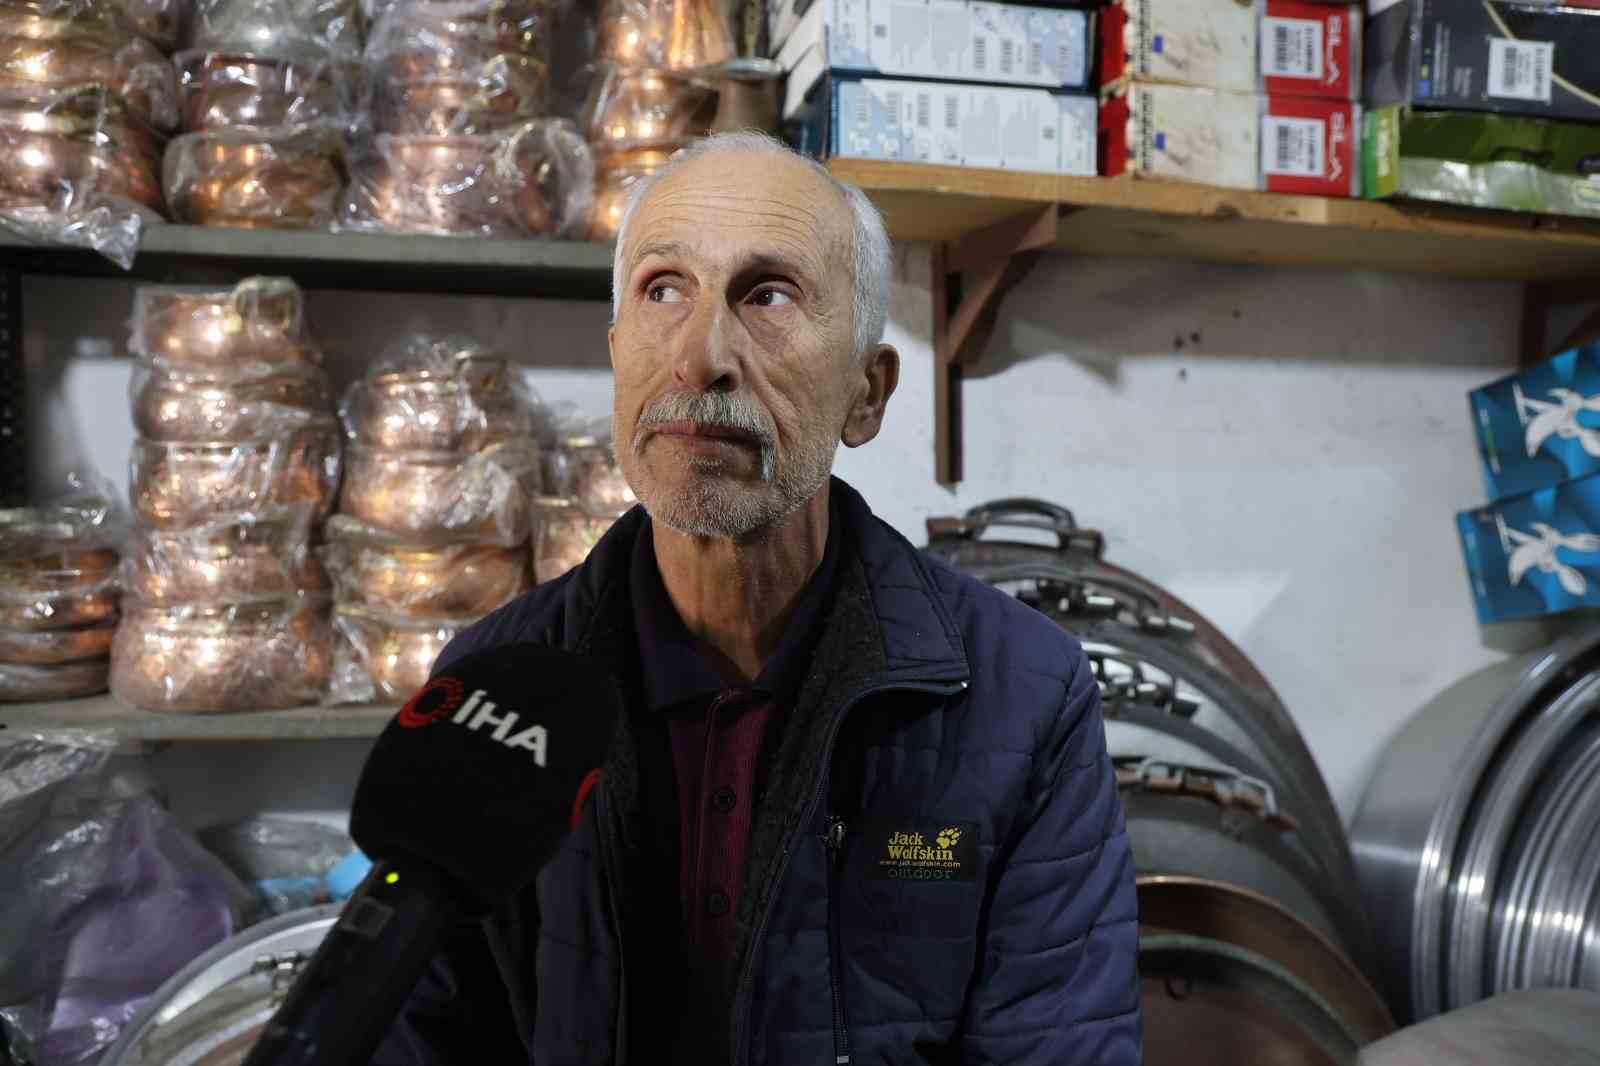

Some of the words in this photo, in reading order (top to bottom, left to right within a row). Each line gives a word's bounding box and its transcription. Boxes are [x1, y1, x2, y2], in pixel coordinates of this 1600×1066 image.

[451, 688, 549, 768] İHA
[888, 831, 924, 845] Jack
[887, 845, 954, 860] Wolfskin
